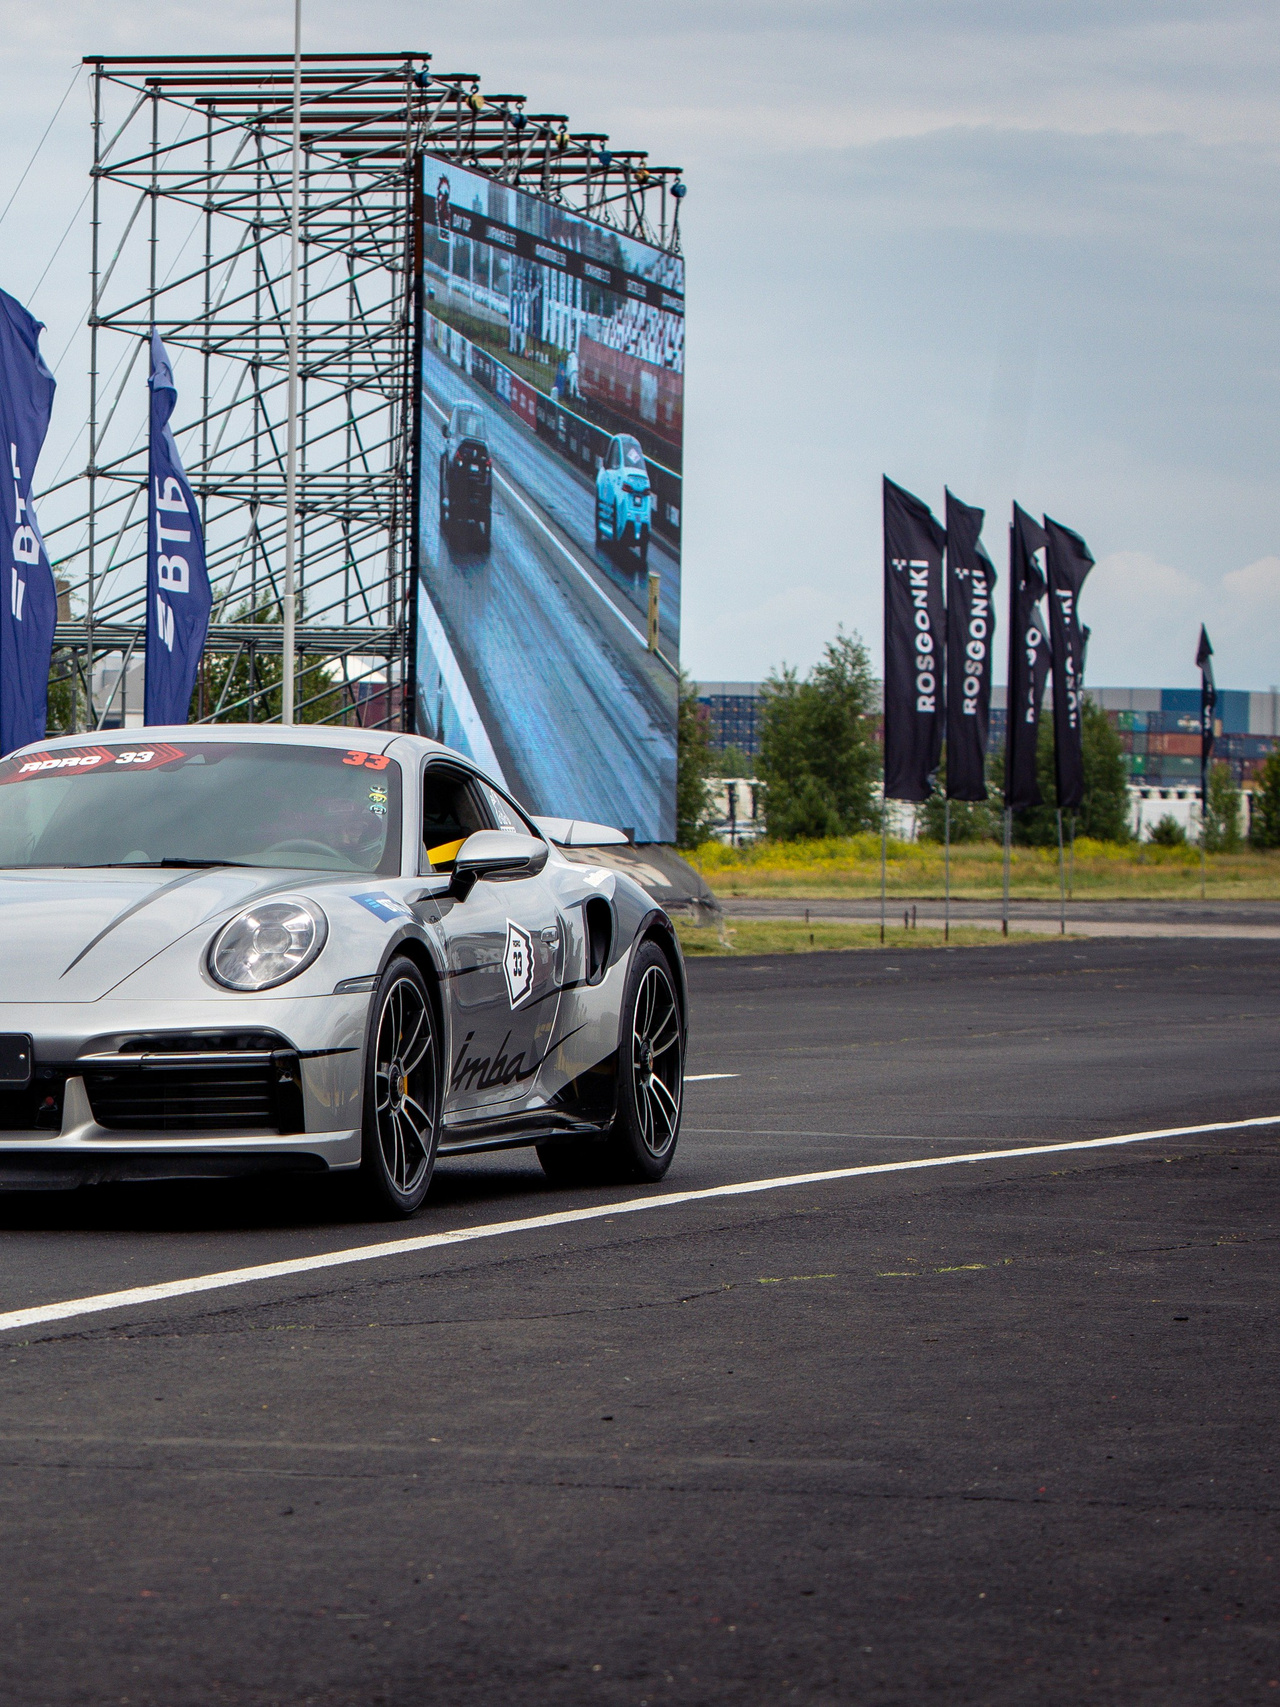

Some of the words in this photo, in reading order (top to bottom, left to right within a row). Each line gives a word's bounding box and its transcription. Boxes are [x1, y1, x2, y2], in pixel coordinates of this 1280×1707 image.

[154, 475, 191, 593] ВТБ
[909, 559, 936, 713] ROSGONKI
[963, 569, 988, 715] ROSGONKI
[114, 751, 155, 764] 33
[342, 750, 391, 771] 33
[512, 951, 523, 977] 33
